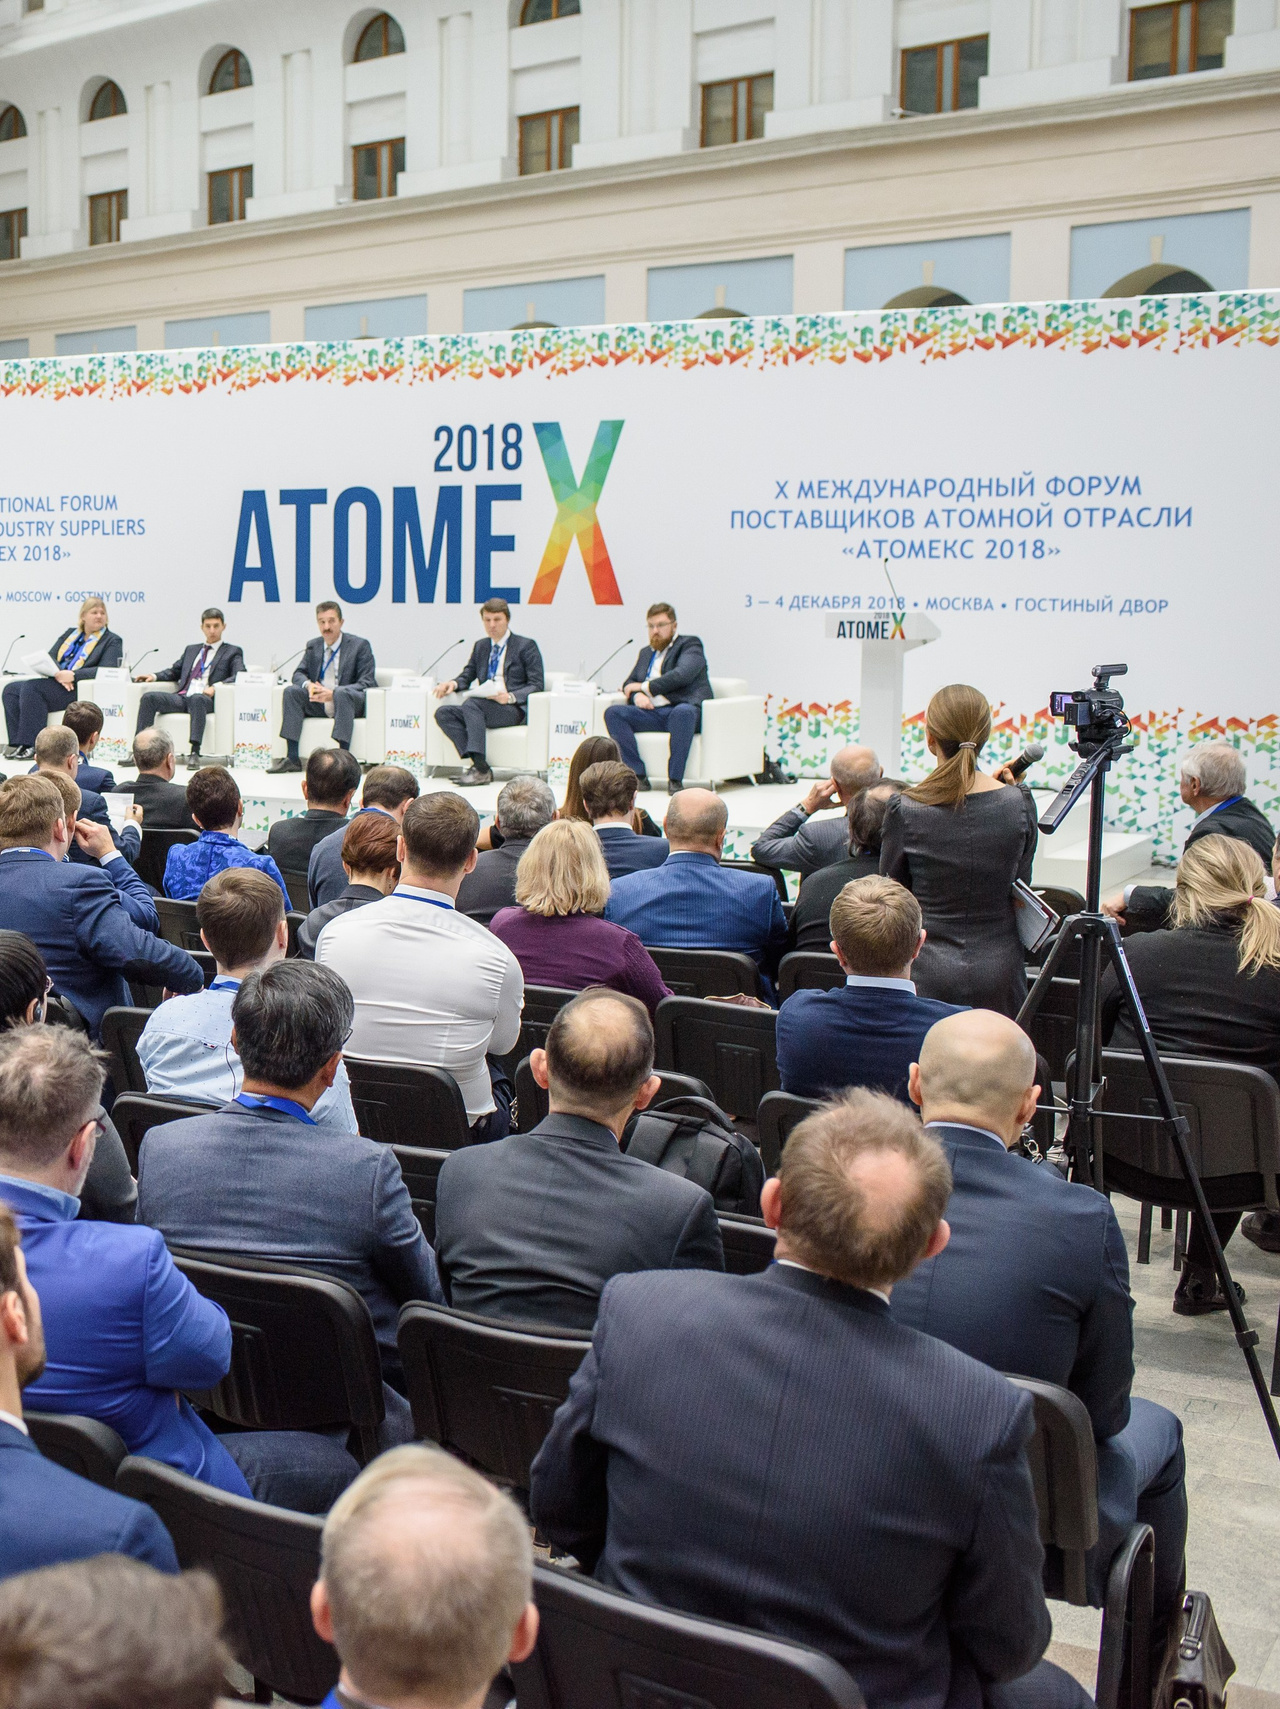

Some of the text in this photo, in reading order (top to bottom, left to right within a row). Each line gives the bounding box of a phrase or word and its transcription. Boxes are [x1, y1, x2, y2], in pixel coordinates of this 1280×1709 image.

[434, 423, 522, 472] 2018
[797, 471, 1036, 503] МЕЖДУНАРОДНЫЙ
[1046, 475, 1142, 498] ФОРУМ
[60, 495, 118, 511] FORUM
[228, 420, 625, 605] ATOMEX
[731, 502, 1193, 534] ПОСТАВЩИКОВ АТОМНОЙ ОТРАСЛИ
[60, 519, 146, 537] SUPPLIERS
[23, 545, 71, 562] 2018»
[842, 538, 1062, 560] «АТОМЕКС 2018»
[6, 591, 53, 602] MOSCOW
[115, 591, 145, 602] DVOR
[745, 595, 753, 608] 3
[775, 595, 784, 608] 4
[789, 595, 861, 612] ДЕКАБРЯ
[867, 596, 906, 610] 2018
[926, 597, 994, 611] МОСКВА
[1015, 595, 1114, 613] ГОСТИНЫЙ
[1119, 598, 1169, 616] ДВОР
[837, 612, 906, 640] ATOMEX
[239, 708, 267, 722] ATOMEX
[390, 715, 420, 728] ATOMEX
[555, 721, 587, 735] ATOMEX
